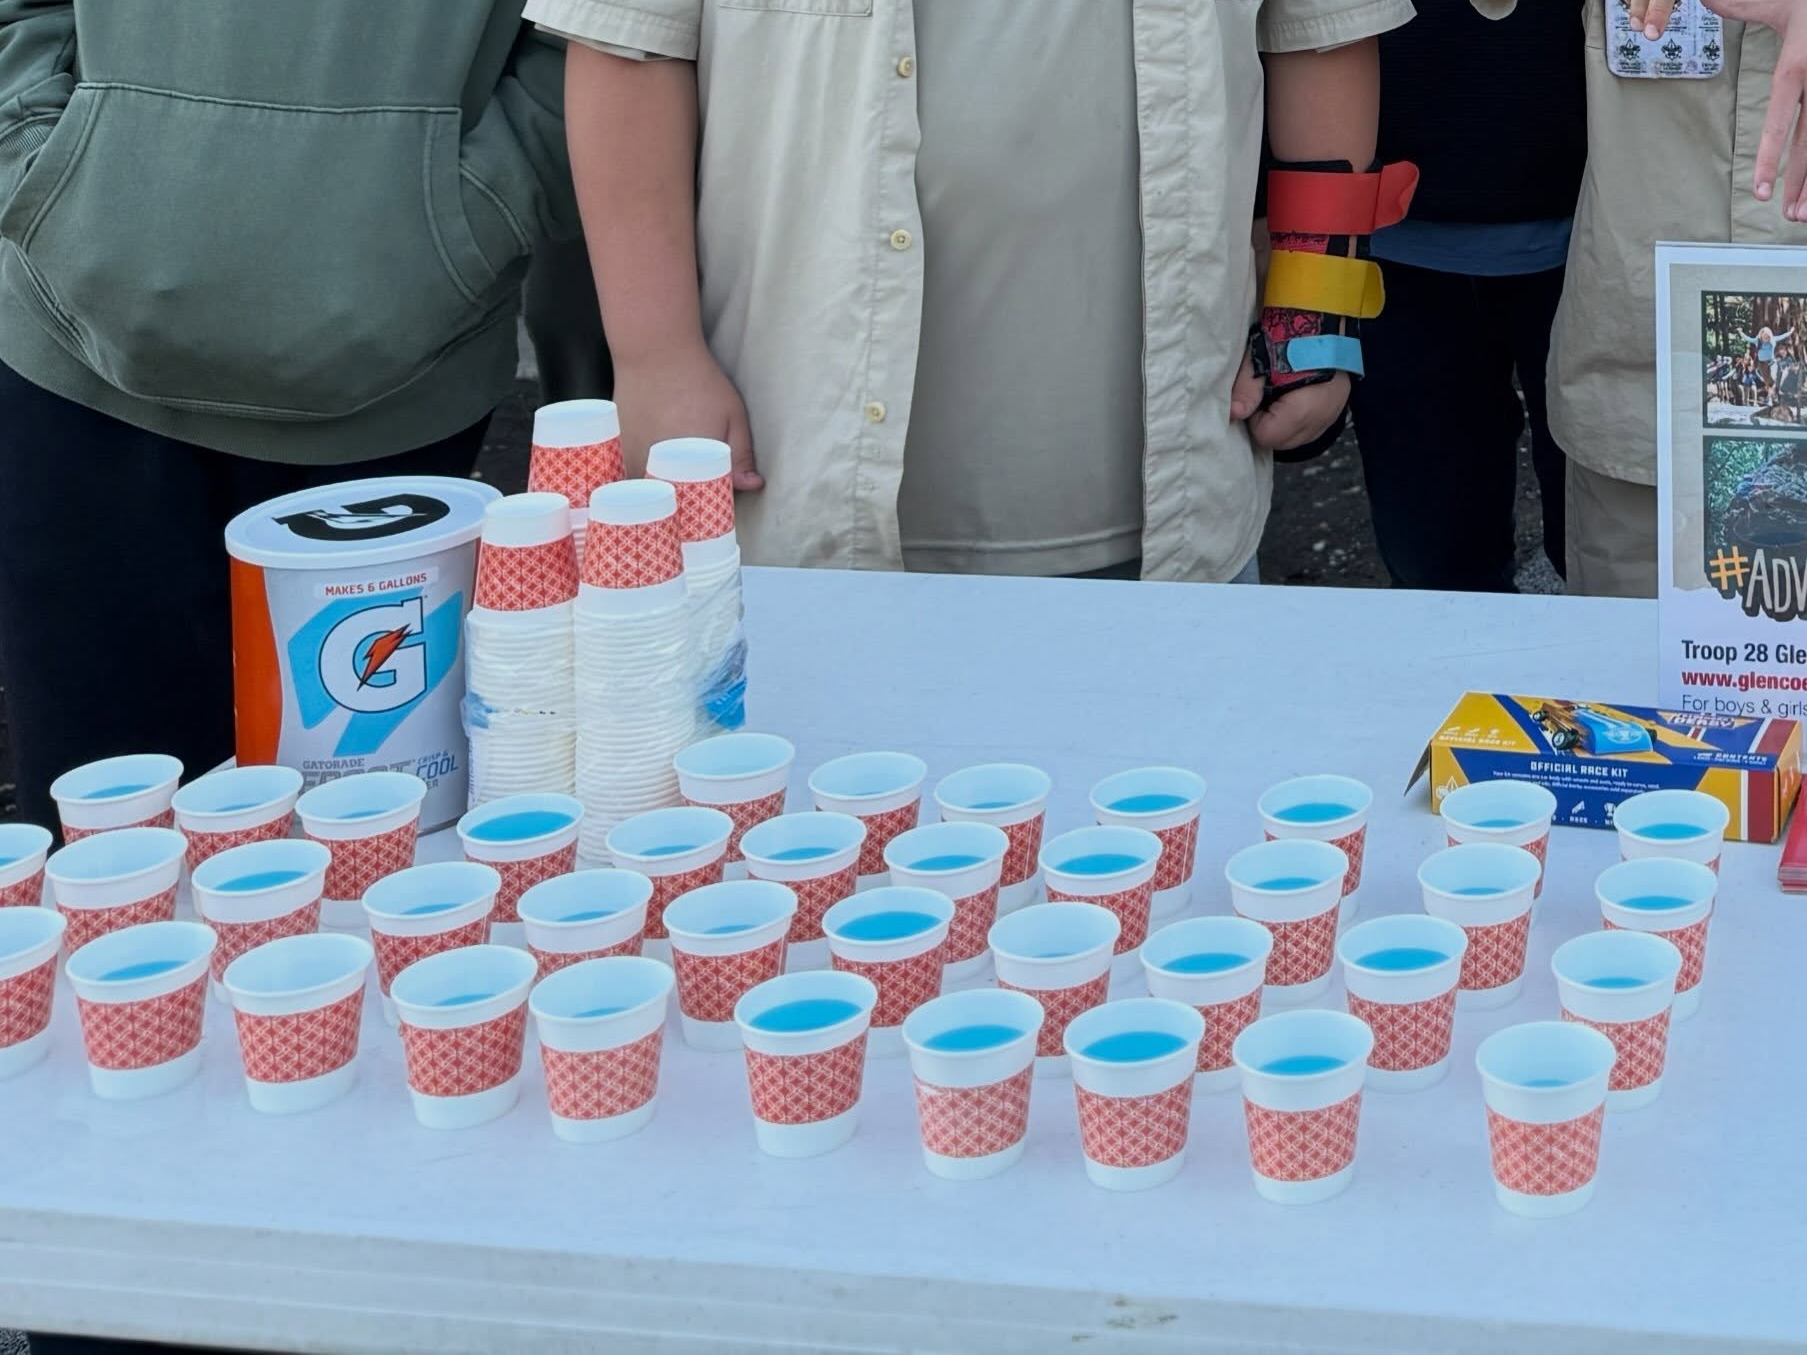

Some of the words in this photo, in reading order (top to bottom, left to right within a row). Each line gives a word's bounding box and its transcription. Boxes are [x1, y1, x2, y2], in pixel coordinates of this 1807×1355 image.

[325, 584, 364, 596] MAKES
[367, 583, 375, 592] 6
[378, 573, 427, 591] GALLONS
[318, 595, 428, 714] G
[1682, 640, 1738, 665] Troop
[1744, 643, 1768, 662] 28
[1682, 695, 1709, 711] For
[1715, 697, 1755, 716] boys
[1761, 699, 1772, 714] &
[303, 758, 365, 770] GATORADE
[417, 752, 442, 766] CRISP
[416, 754, 459, 779] COOL
[1530, 761, 1578, 774] OFFICIAL
[1580, 765, 1608, 776] RACE
[1611, 767, 1628, 778] KIT
